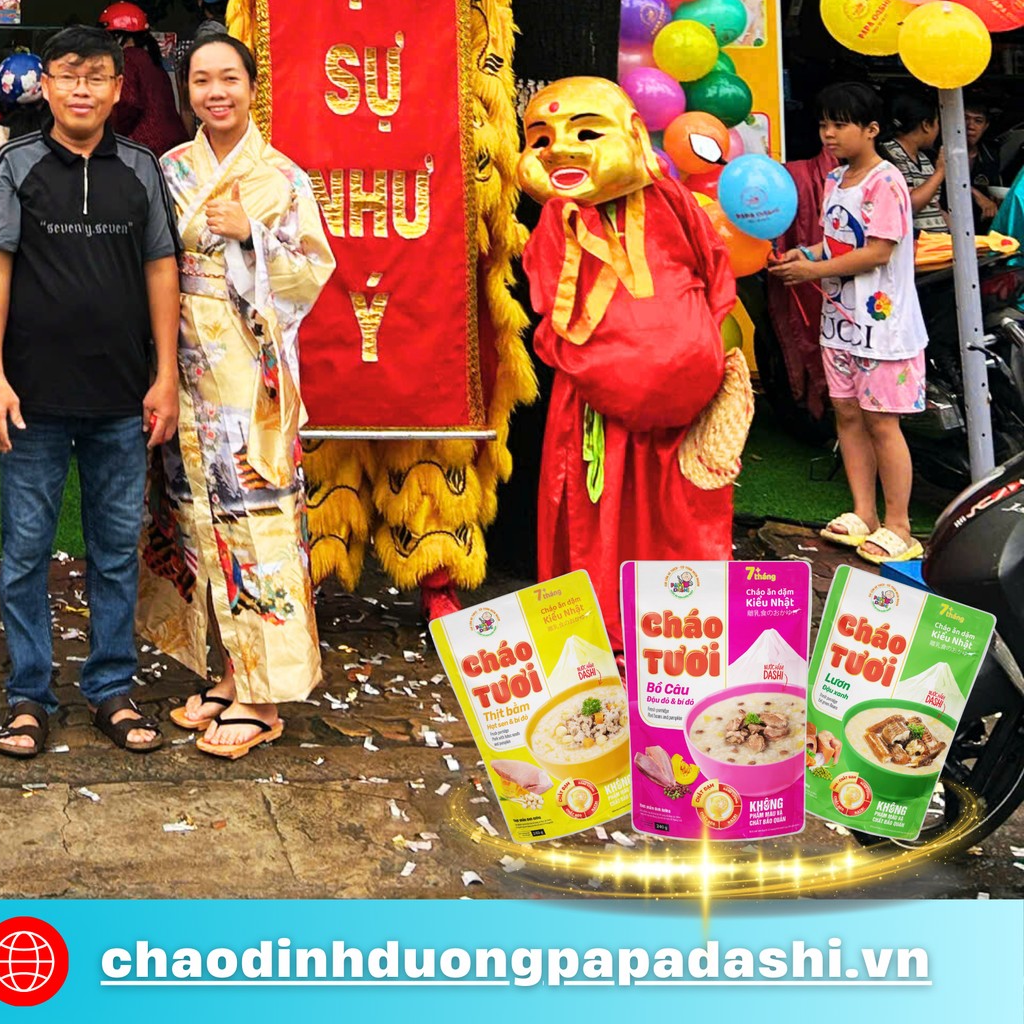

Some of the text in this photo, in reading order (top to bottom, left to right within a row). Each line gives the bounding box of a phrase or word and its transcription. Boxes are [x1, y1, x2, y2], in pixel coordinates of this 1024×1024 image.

[324, 30, 405, 132] SỰ
[308, 153, 435, 240] NHƯ
[350, 273, 390, 363] Ý
[822, 319, 873, 349] UCCI
